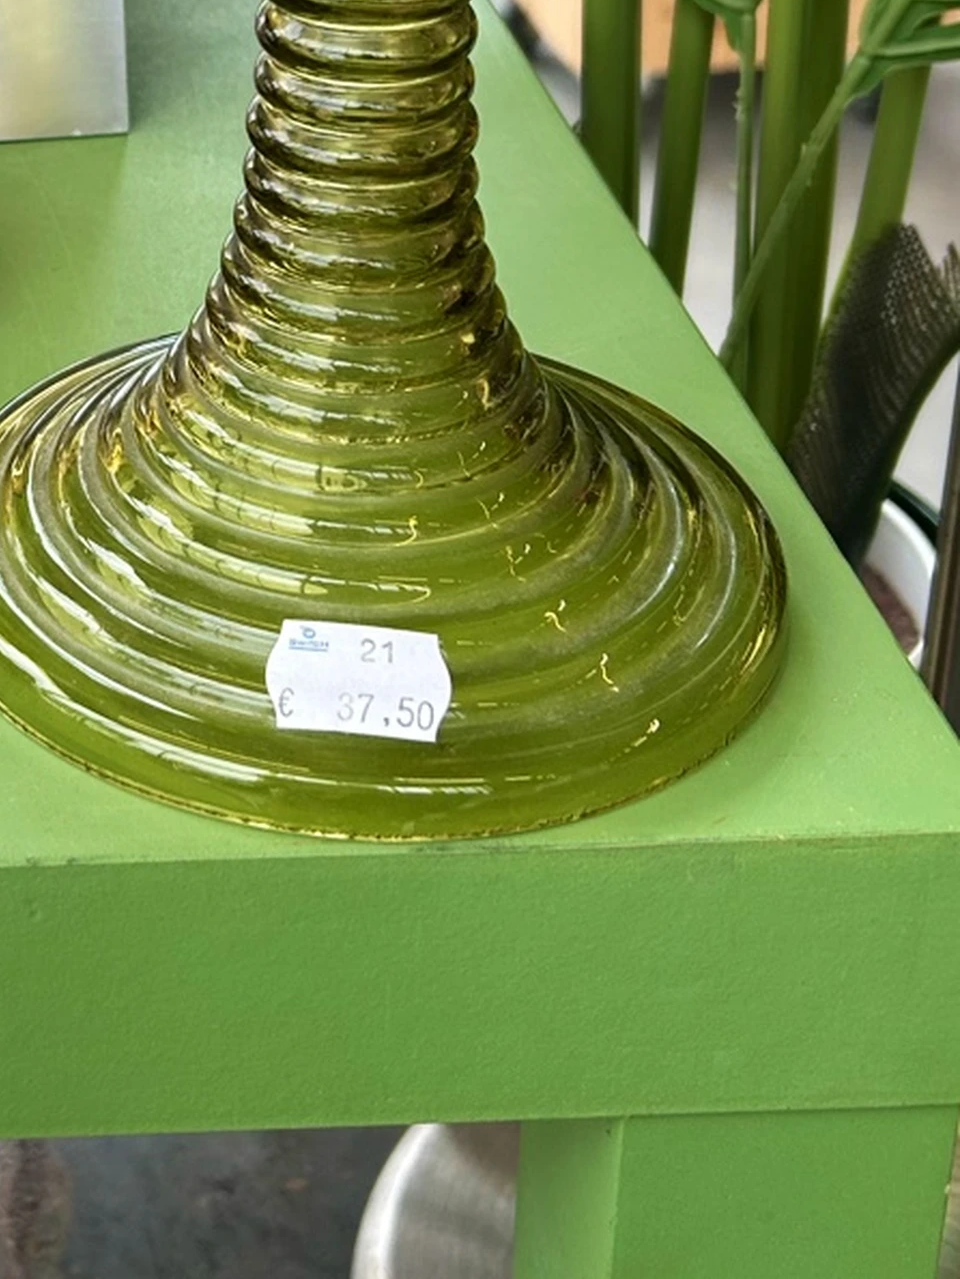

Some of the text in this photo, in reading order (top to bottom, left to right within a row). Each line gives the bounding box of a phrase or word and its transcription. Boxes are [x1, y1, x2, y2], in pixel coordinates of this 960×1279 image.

[360, 637, 394, 663] 21
[278, 687, 435, 731] € 37,50
